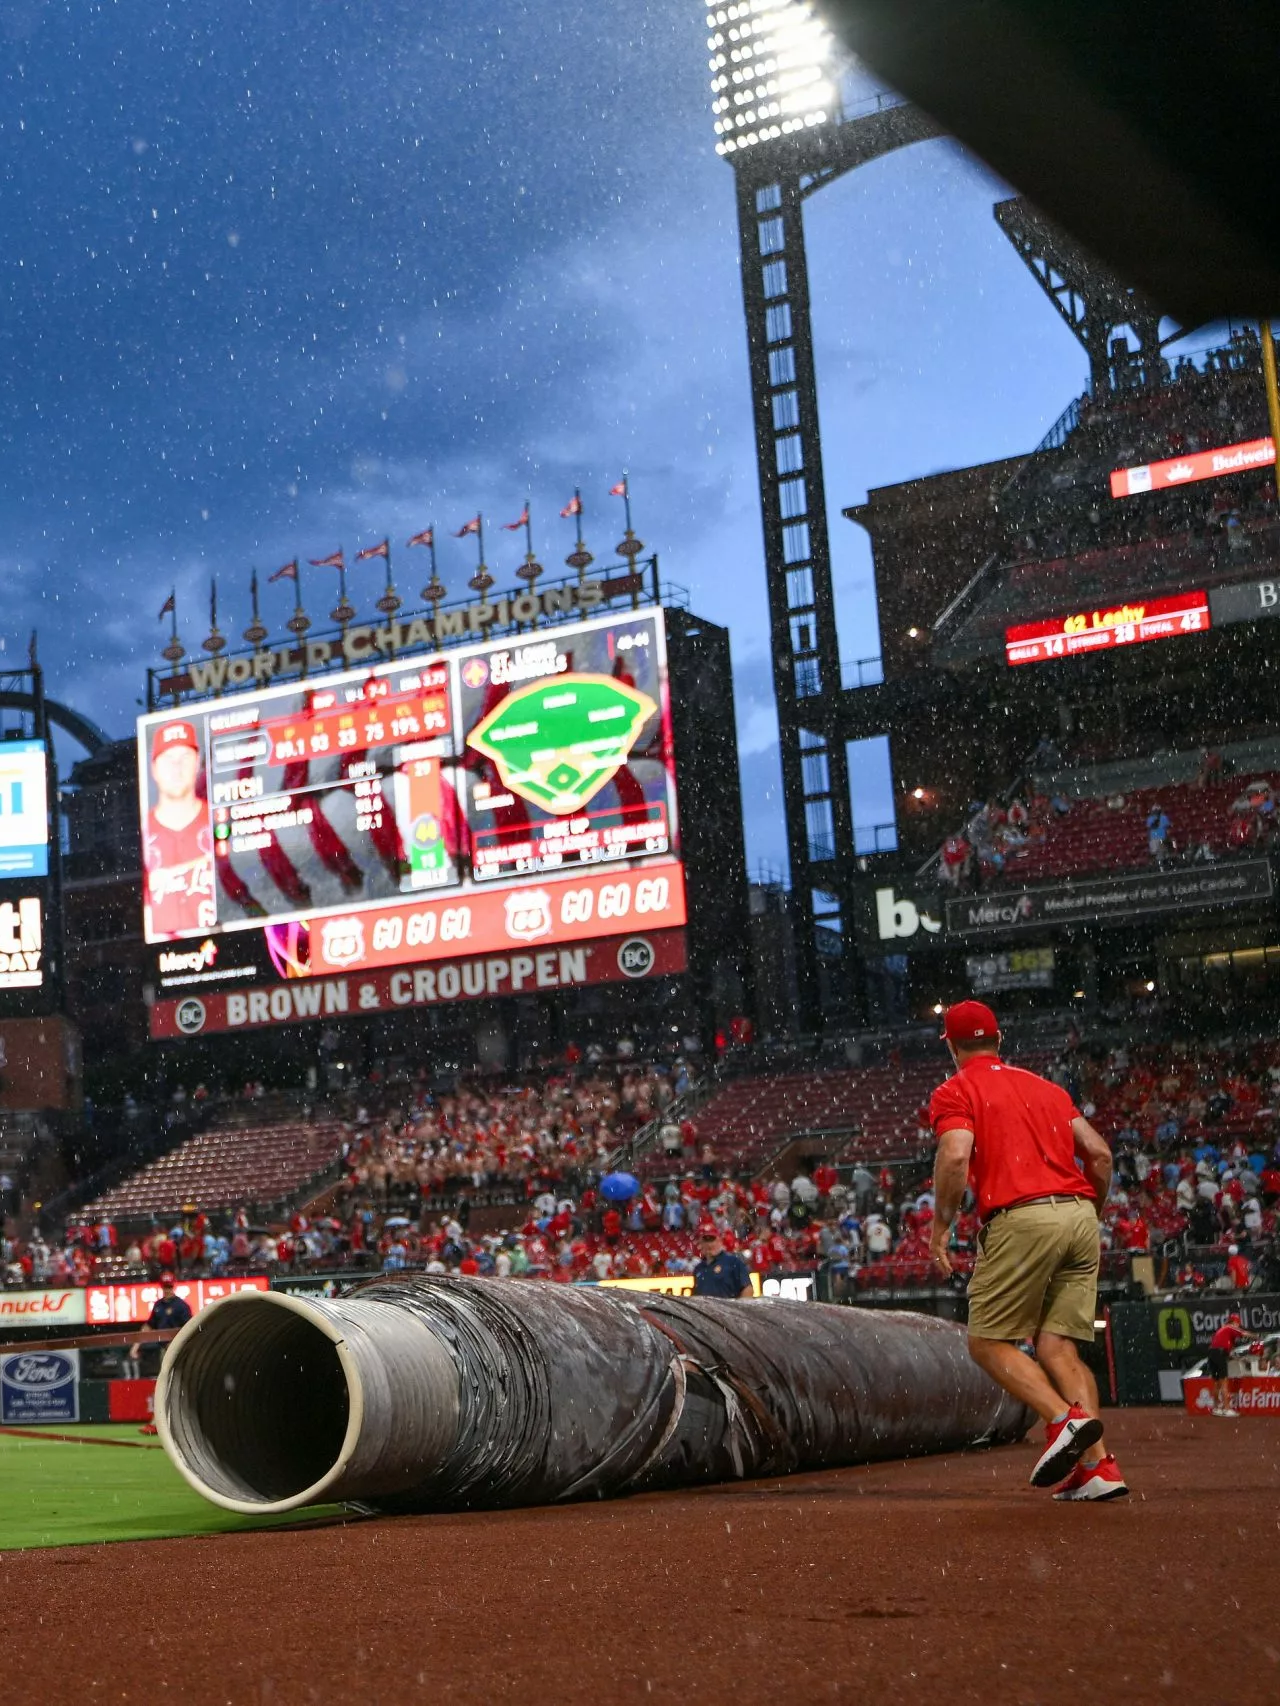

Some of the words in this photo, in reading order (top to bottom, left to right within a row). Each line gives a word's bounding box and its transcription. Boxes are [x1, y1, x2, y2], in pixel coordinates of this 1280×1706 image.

[1093, 605, 1145, 628] Leahy
[189, 643, 331, 692] WORLD
[344, 581, 603, 659] CHAMPIONS
[1044, 640, 1063, 656] 14
[1180, 613, 1201, 630] 42
[365, 723, 384, 742] 75
[213, 776, 263, 803] PITCH
[373, 916, 403, 951] GO
[407, 911, 436, 945] GO
[441, 907, 470, 940] GO
[561, 888, 593, 924] GO
[598, 882, 630, 919] GO
[635, 877, 669, 914] GO
[968, 904, 1019, 925] Mercy
[226, 980, 349, 1026] BROWN
[359, 983, 380, 1009] &
[389, 947, 588, 1005] CROUPPEN
[1193, 1308, 1249, 1332] Cordll
[14, 1355, 61, 1382] Ford
